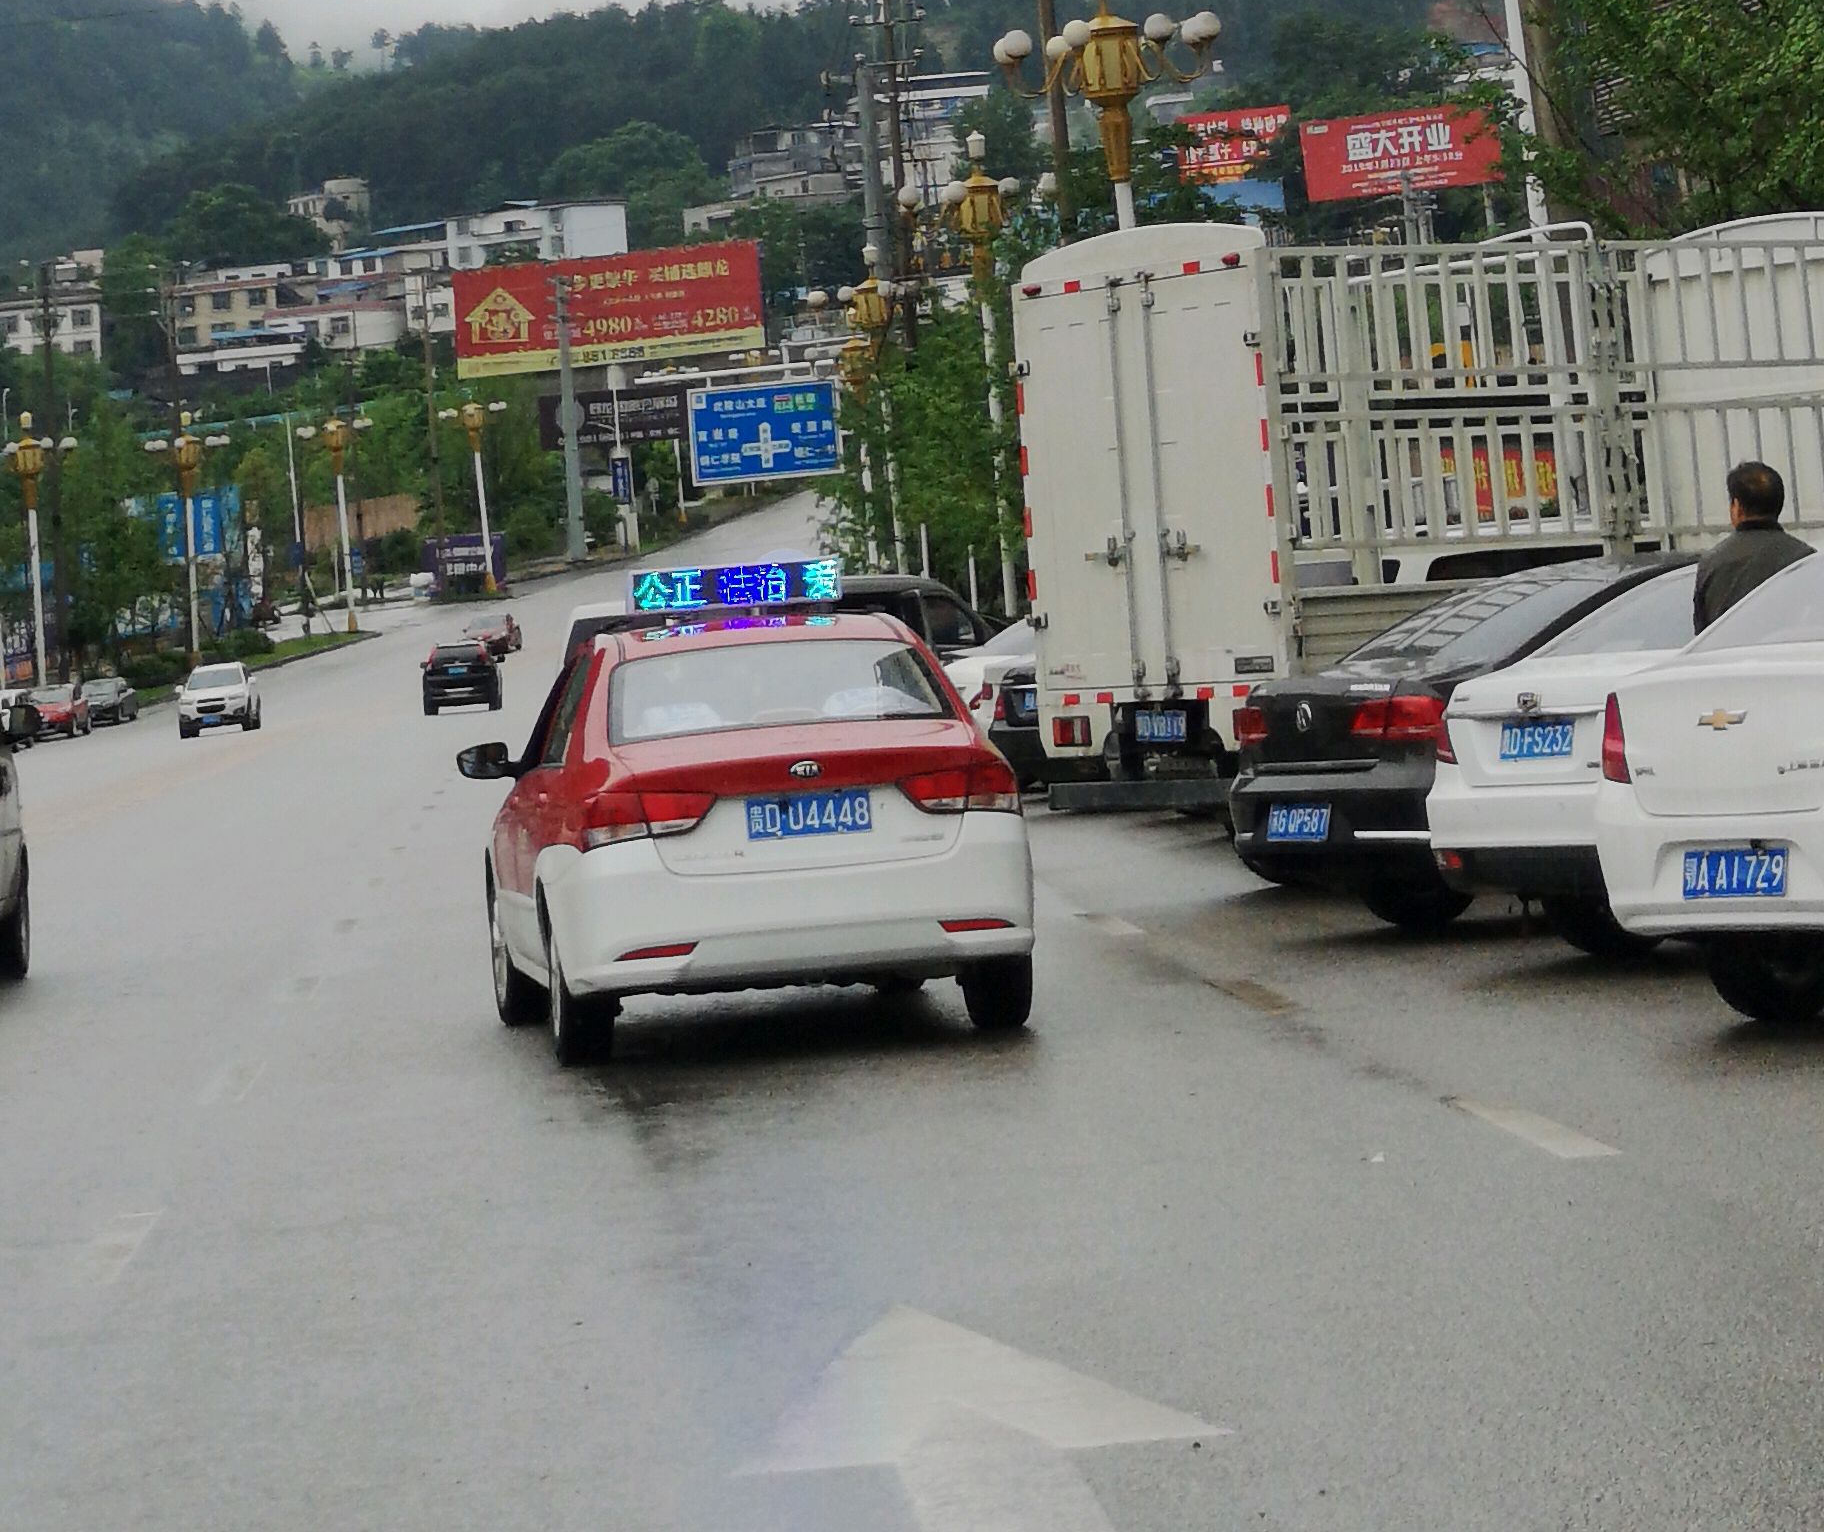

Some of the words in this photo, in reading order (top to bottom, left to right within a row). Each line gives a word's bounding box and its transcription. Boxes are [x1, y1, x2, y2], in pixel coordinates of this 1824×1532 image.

[1346, 123, 1454, 161] 盛大开业
[582, 316, 632, 337] 4980
[692, 306, 740, 328] 4280
[633, 569, 708, 610] 公正
